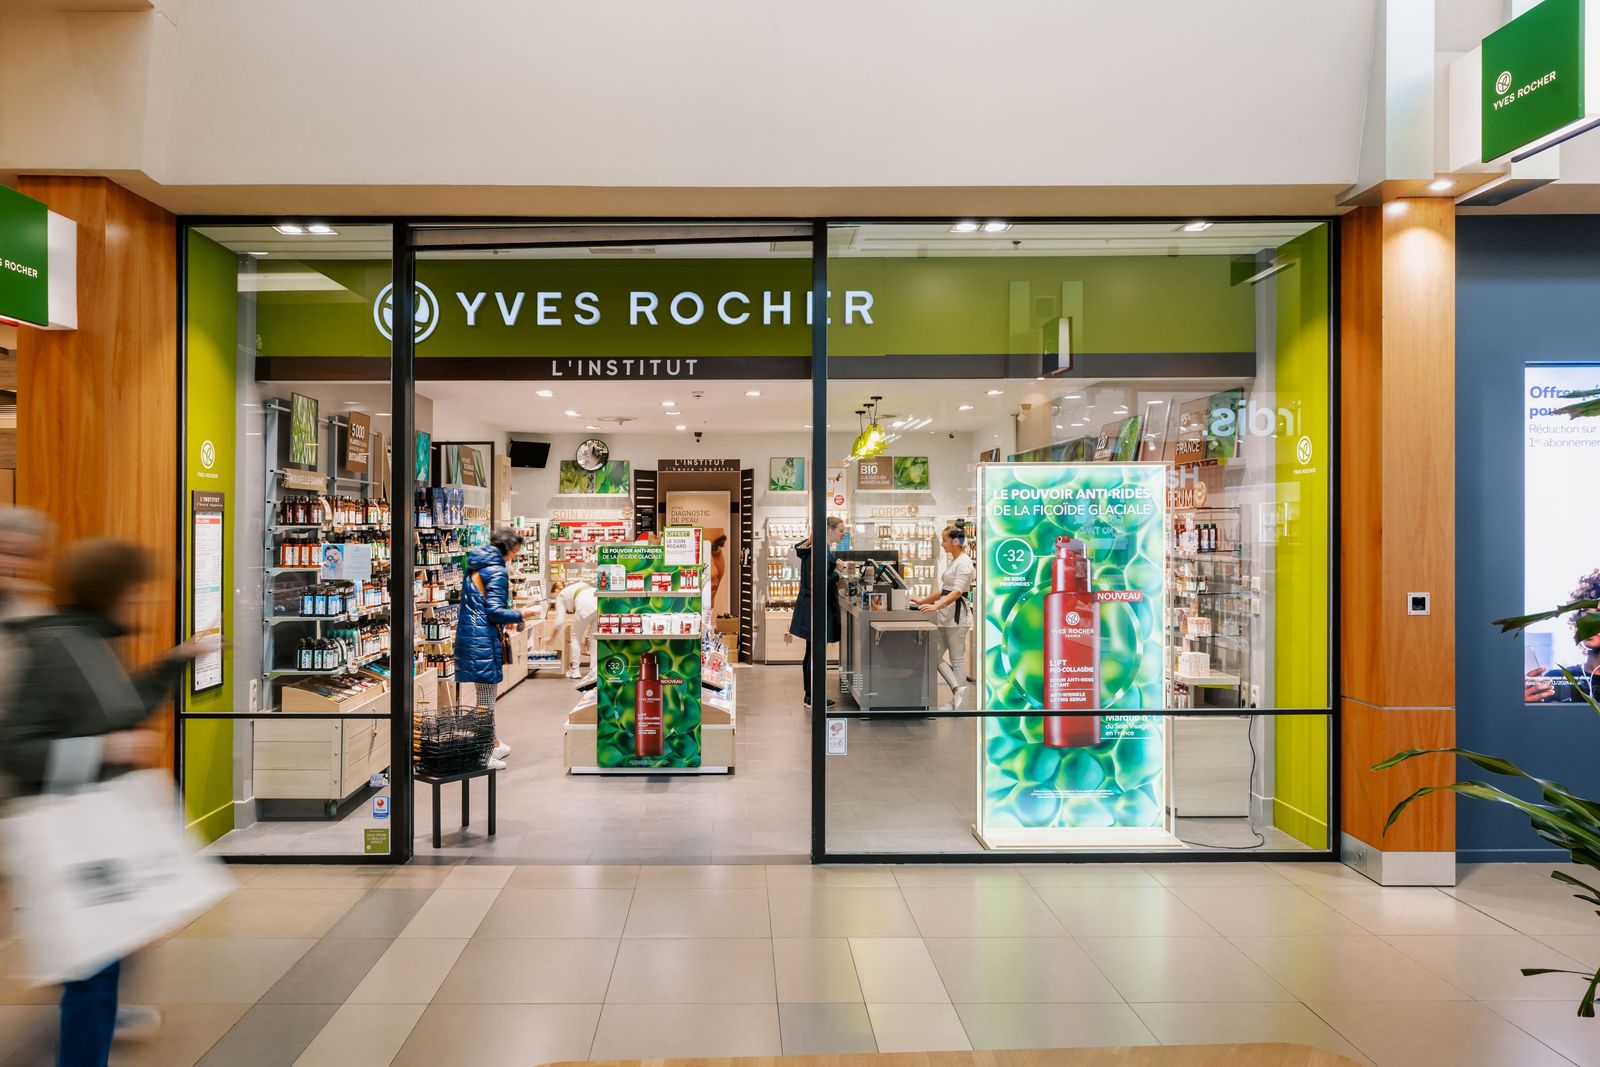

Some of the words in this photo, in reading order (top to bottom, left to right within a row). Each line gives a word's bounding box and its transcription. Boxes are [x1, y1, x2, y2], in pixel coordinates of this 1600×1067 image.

[1492, 93, 1515, 110] YVES
[1517, 71, 1556, 98] ROCHER
[4, 259, 38, 278] ROCHER
[456, 291, 601, 326] YVES
[552, 360, 698, 376] L'INSTITUT
[1529, 424, 1580, 433] Réduction
[1176, 442, 1200, 455] FRANCE
[860, 465, 878, 475] BIO
[993, 488, 1009, 500] LE
[1011, 488, 1073, 500] POUVOIR
[1075, 488, 1150, 500] ANTI-RIDES
[993, 505, 1011, 516] DE
[1014, 505, 1030, 516] LA
[1033, 502, 1084, 516] FICOÏDE
[1088, 504, 1150, 515] GLACIALE
[1003, 550, 1024, 562] -32
